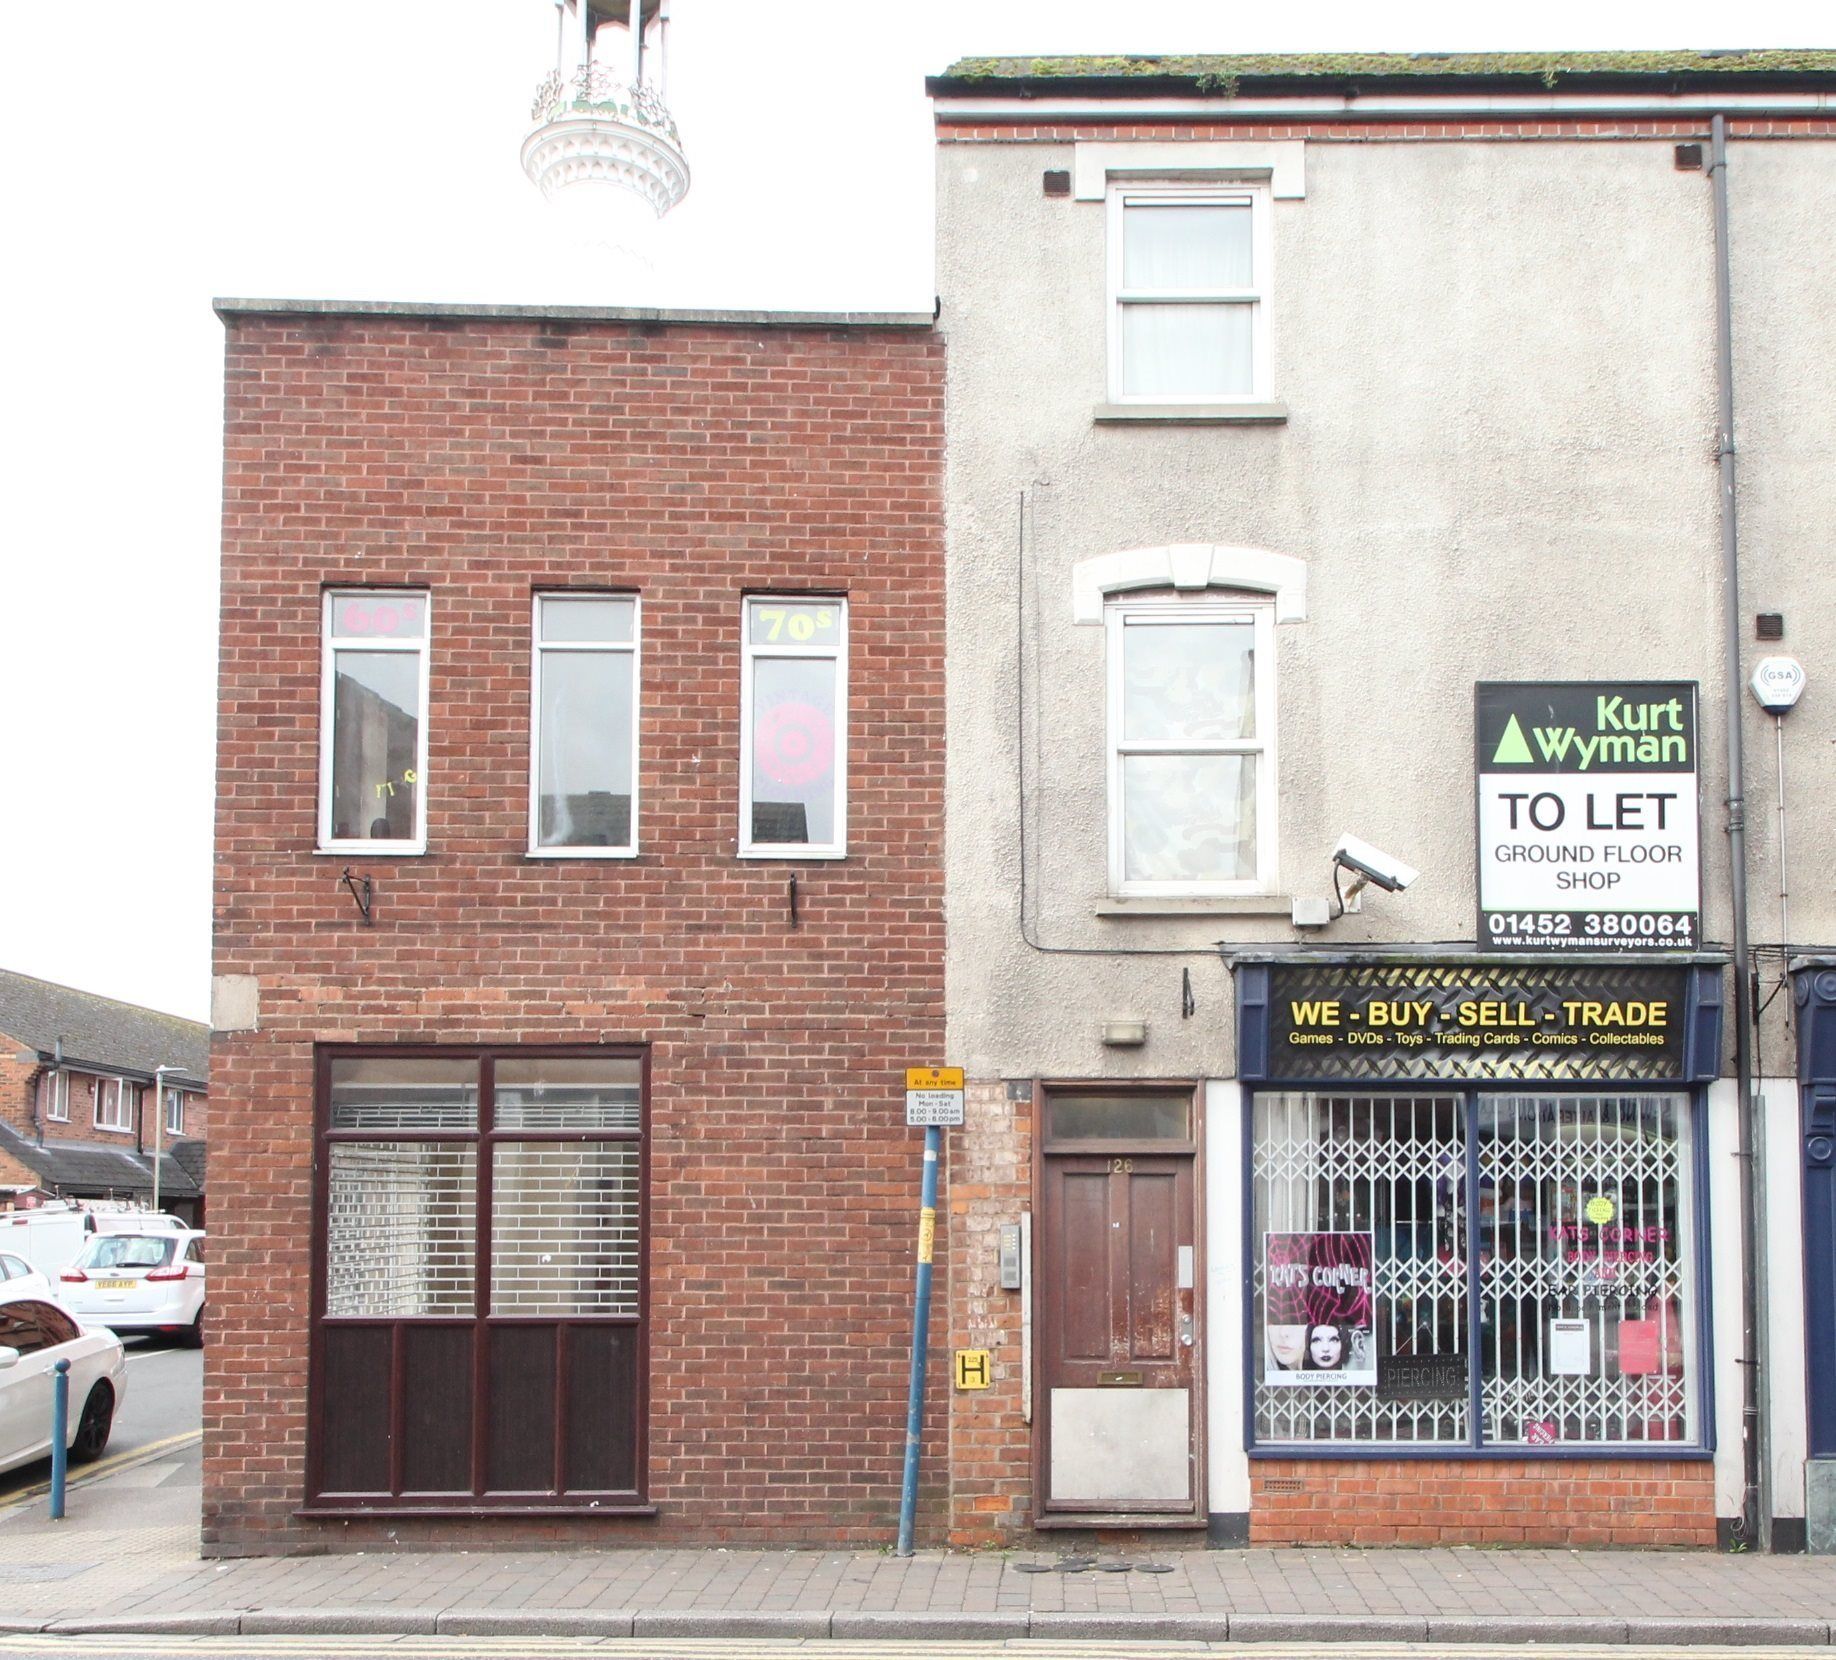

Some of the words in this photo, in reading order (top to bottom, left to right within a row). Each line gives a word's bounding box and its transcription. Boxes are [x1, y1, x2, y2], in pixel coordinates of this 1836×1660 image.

[1768, 671, 1793, 680] GSA
[1597, 695, 1684, 731] Kurt
[1533, 727, 1686, 770] Wyman
[1498, 792, 1566, 831] TO
[1586, 793, 1677, 831] LET
[1494, 845, 1594, 863] GROUND
[1604, 845, 1682, 863] FLOOR
[1556, 871, 1621, 890] SHOP
[1489, 914, 1572, 935] 01452
[1584, 914, 1692, 935] 380064
[1492, 935, 1693, 948] www.kurtwymansurveyors.co.uk
[1291, 1001, 1340, 1026] WE
[1368, 1001, 1433, 1026] BUY
[1458, 1001, 1535, 1027] SELL
[1562, 1001, 1667, 1026] TRADE
[1289, 1032, 1333, 1045] Games
[1348, 1032, 1383, 1045] DVDs
[1395, 1032, 1423, 1047] Toys
[1435, 1032, 1480, 1047] Trading
[1484, 1032, 1520, 1045] Cards
[1532, 1032, 1578, 1045] Comics
[1589, 1032, 1665, 1045] Collectables
[1108, 1159, 1133, 1173] 126
[1600, 1226, 1671, 1242] CORNER
[1312, 1263, 1372, 1294] CORNER
[962, 1355, 984, 1384] H
[1387, 1366, 1456, 1388] PIERCING
